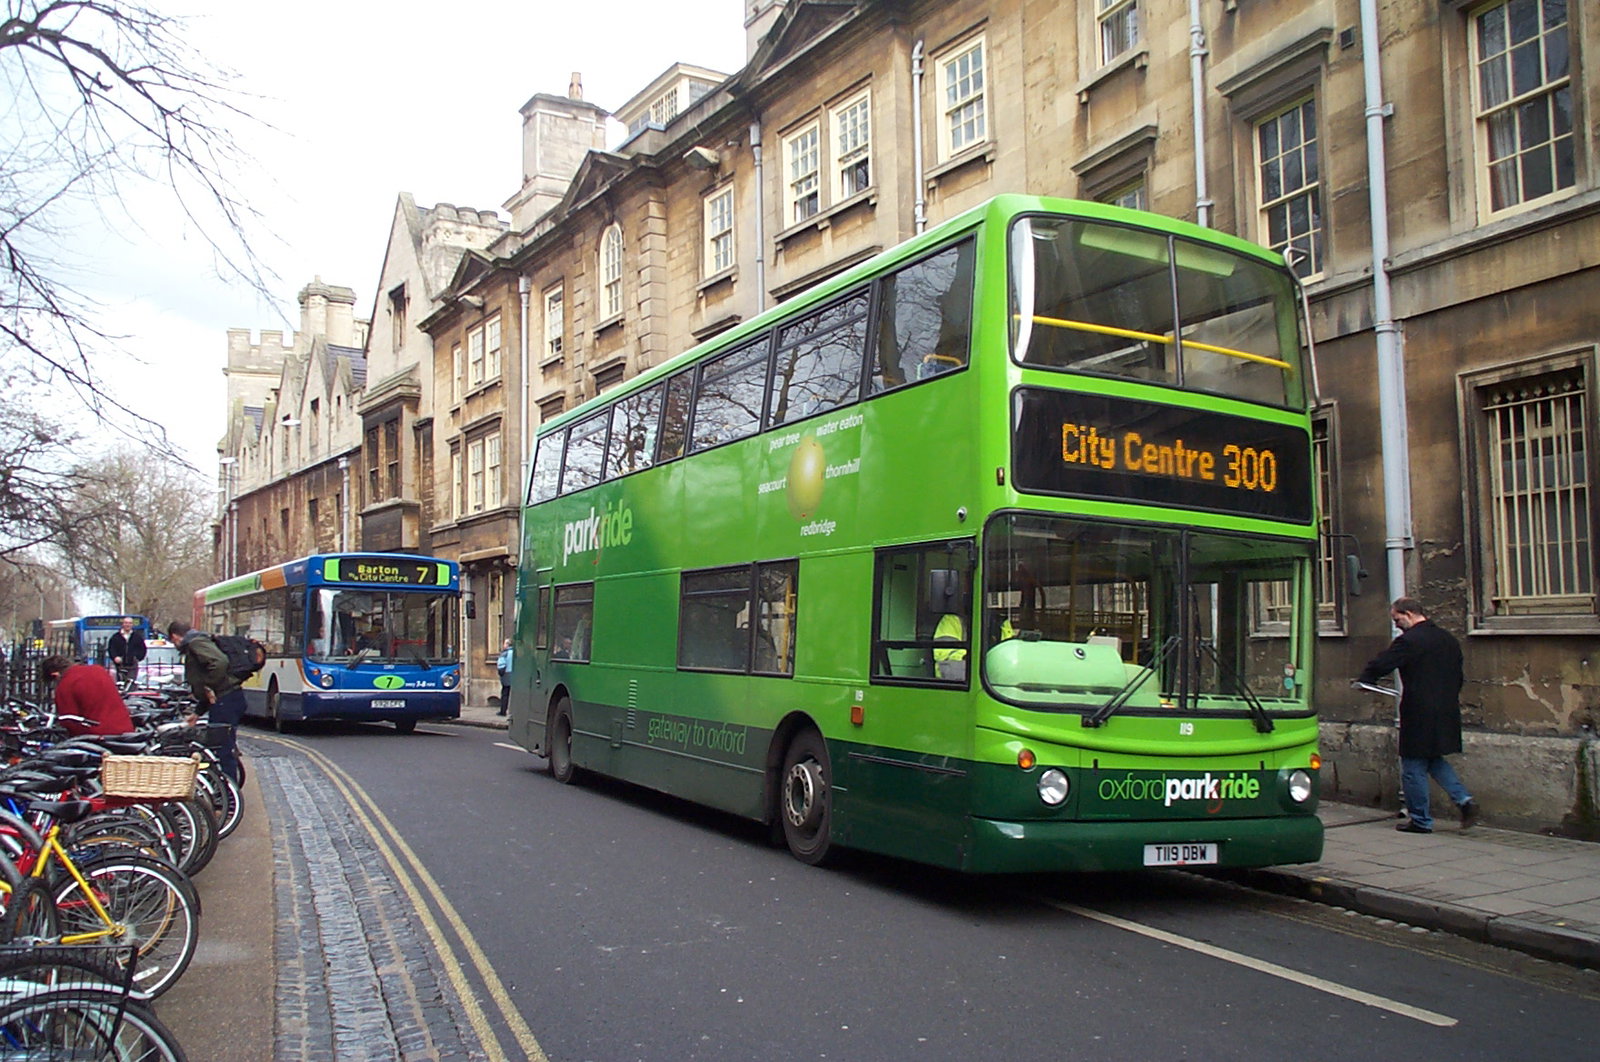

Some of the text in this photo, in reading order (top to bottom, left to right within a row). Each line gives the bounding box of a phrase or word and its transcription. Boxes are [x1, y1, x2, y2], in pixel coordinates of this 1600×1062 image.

[816, 414, 864, 437] water eaton
[769, 432, 801, 453] pear tree
[1061, 422, 1277, 492] City Centre 300
[825, 458, 861, 479] thornhill
[758, 477, 787, 494] seacourt
[800, 519, 837, 537] redbridge
[357, 564, 399, 575] Barton
[359, 573, 378, 582] City
[378, 574, 409, 583] Centre
[416, 566, 429, 583] 7
[386, 676, 394, 688] 7
[647, 715, 748, 755] gateway to oxford
[1155, 844, 1207, 862] T119 DBW
